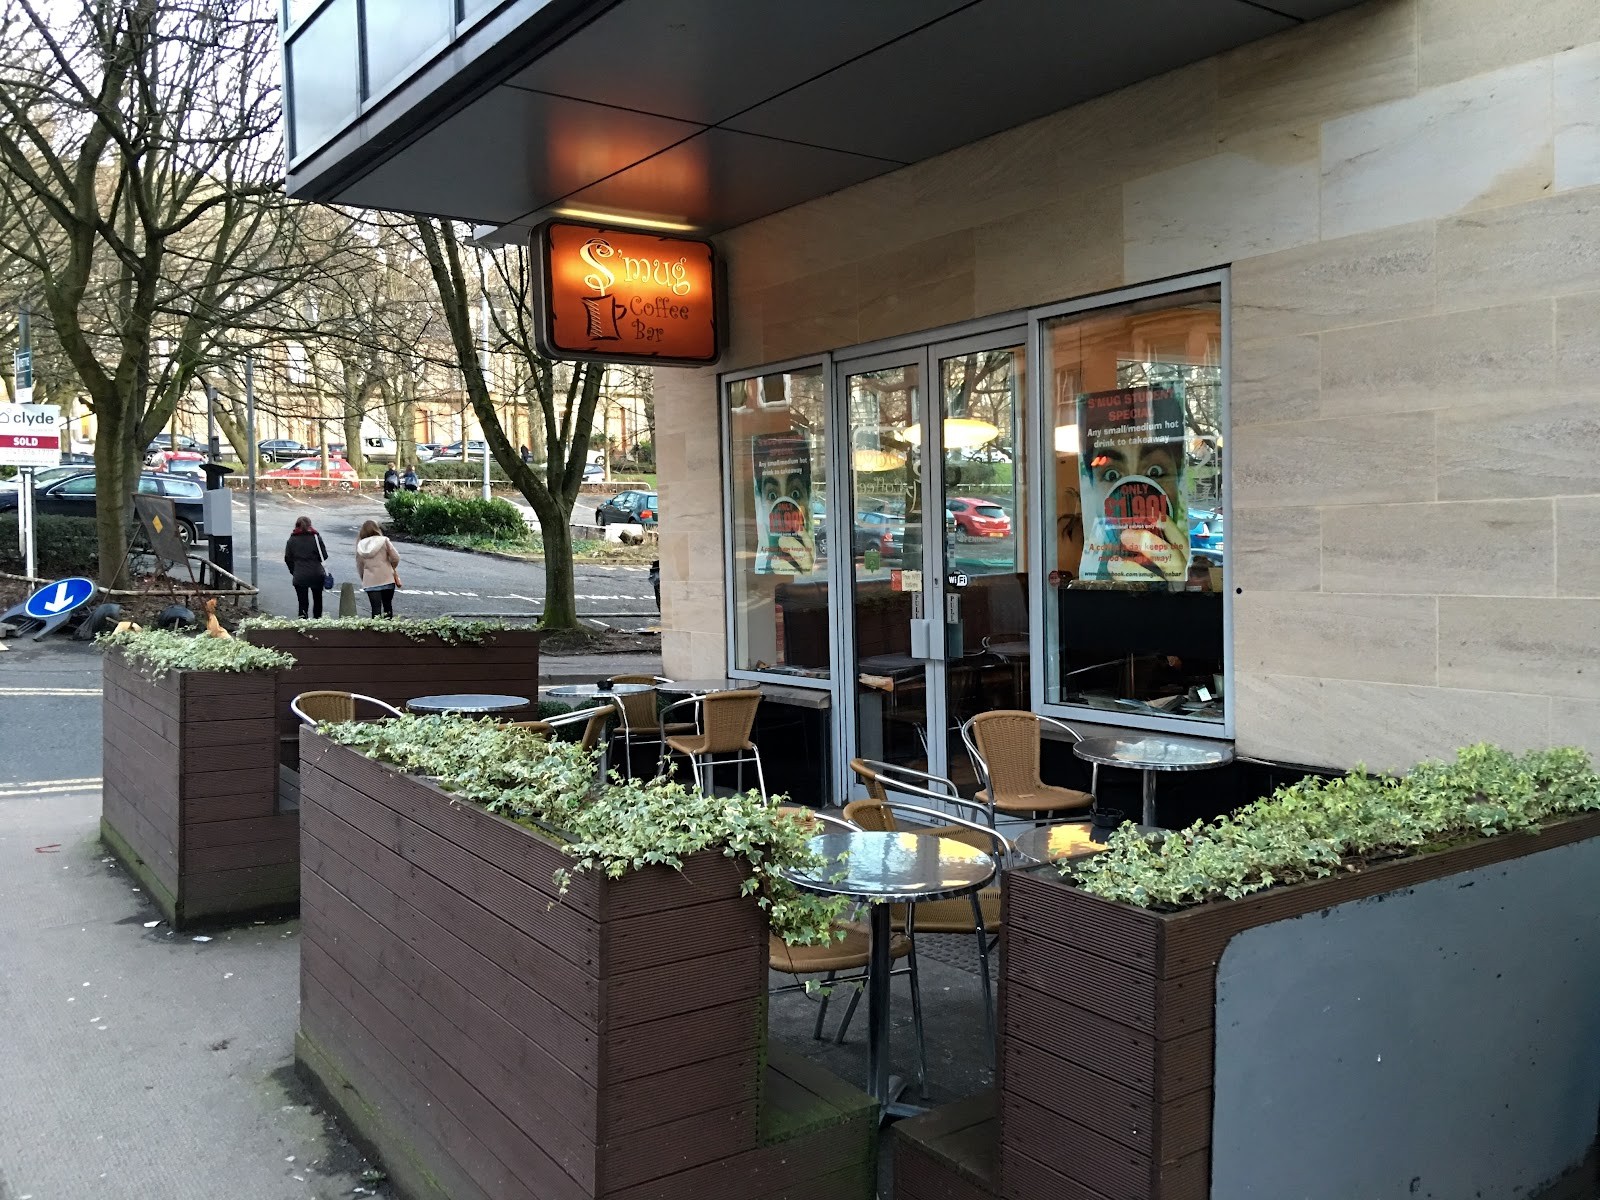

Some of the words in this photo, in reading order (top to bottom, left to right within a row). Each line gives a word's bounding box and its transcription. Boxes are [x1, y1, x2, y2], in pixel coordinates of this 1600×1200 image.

[579, 237, 691, 297] S'mug
[629, 296, 689, 320] Coffee
[631, 318, 664, 342] Bar
[13, 411, 54, 427] clyde
[1087, 428, 1101, 438] Any
[1104, 422, 1162, 436] small/medium
[1165, 420, 1179, 429] hot
[13, 437, 39, 446] SOLD
[1094, 438, 1115, 448] drink
[1117, 438, 1127, 446] to
[1129, 434, 1170, 445] takeaway
[1121, 484, 1149, 495] ONLY
